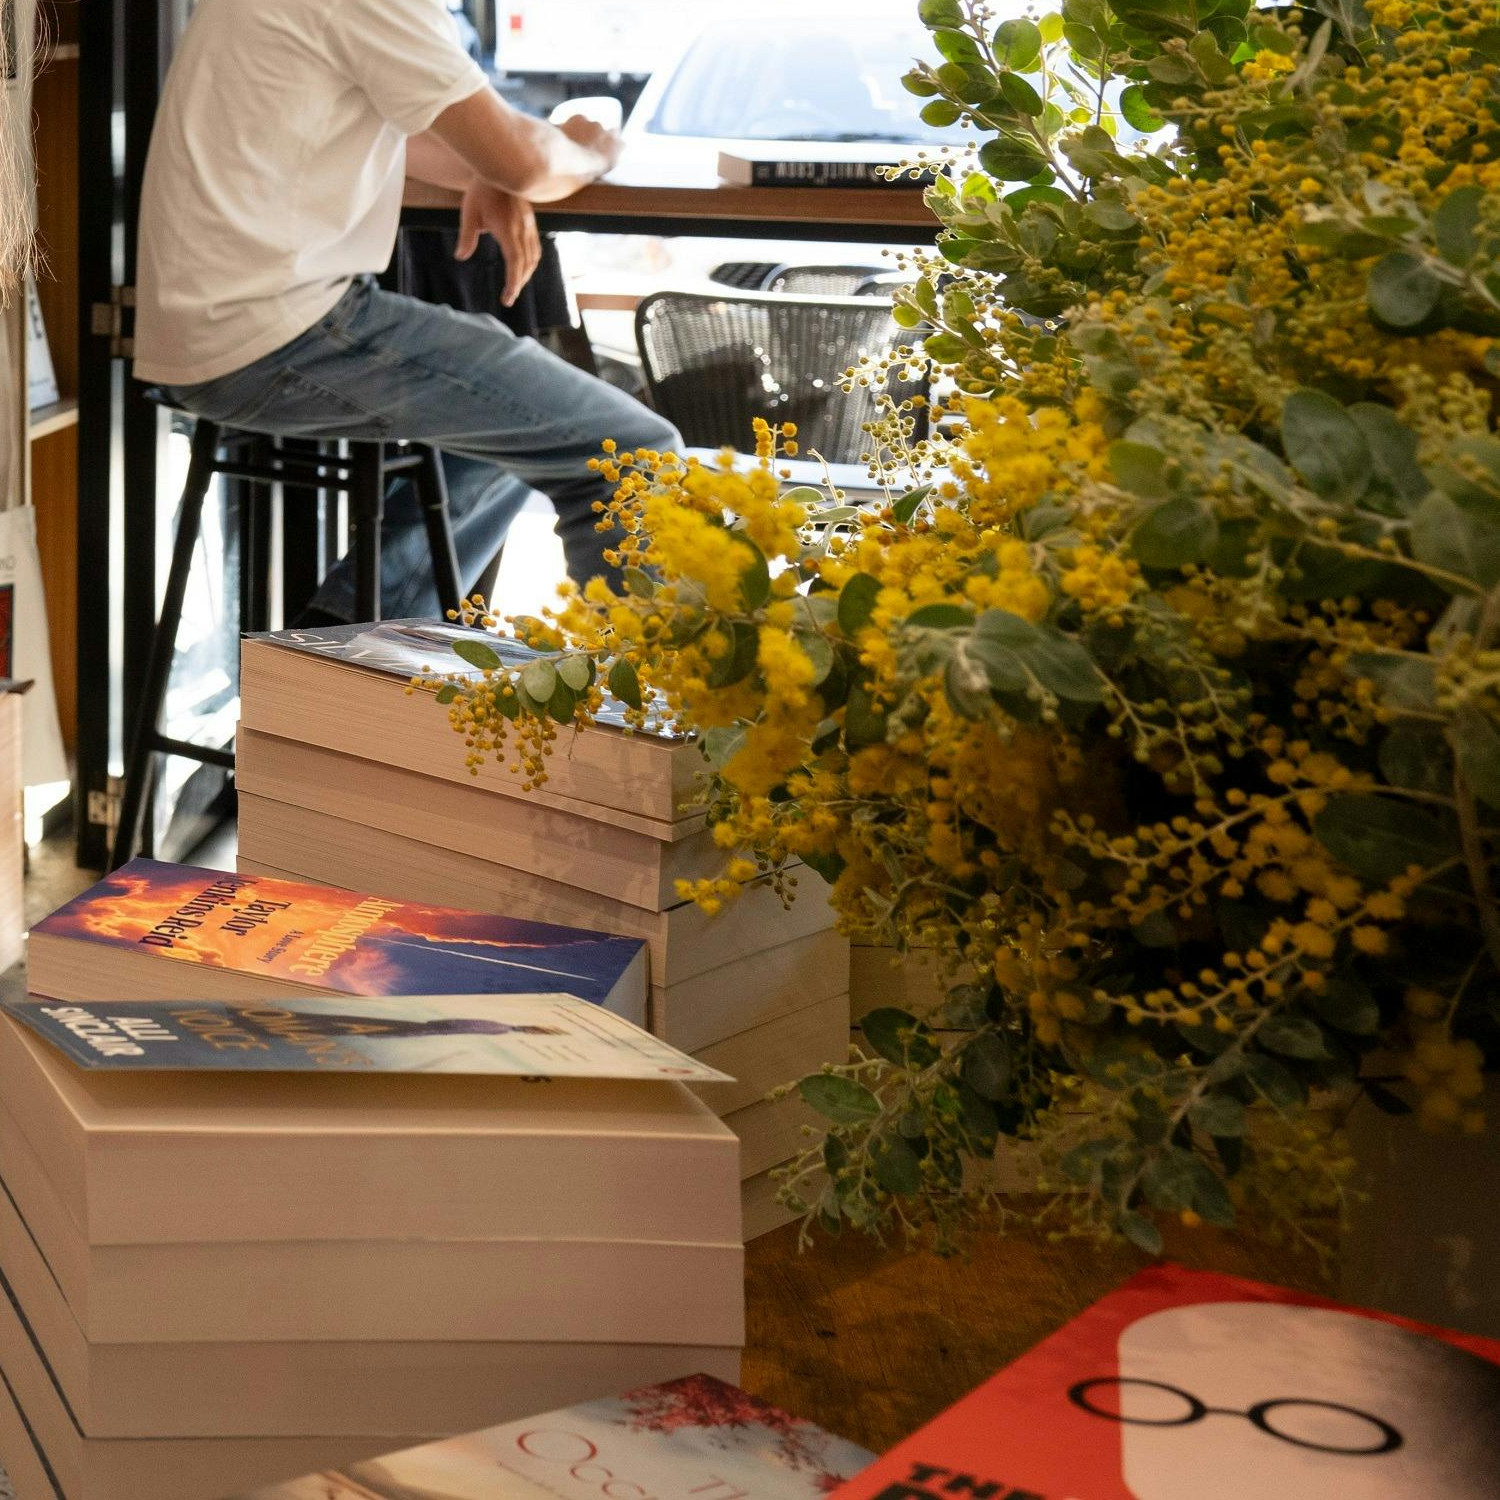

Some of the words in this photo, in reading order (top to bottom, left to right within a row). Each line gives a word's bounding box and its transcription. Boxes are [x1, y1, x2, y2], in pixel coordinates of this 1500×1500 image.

[226, 898, 292, 936] Taylor
[290, 897, 406, 978] Atmosphere
[39, 1005, 146, 1059] SINCLAIR
[106, 1014, 180, 1044] ALLI
